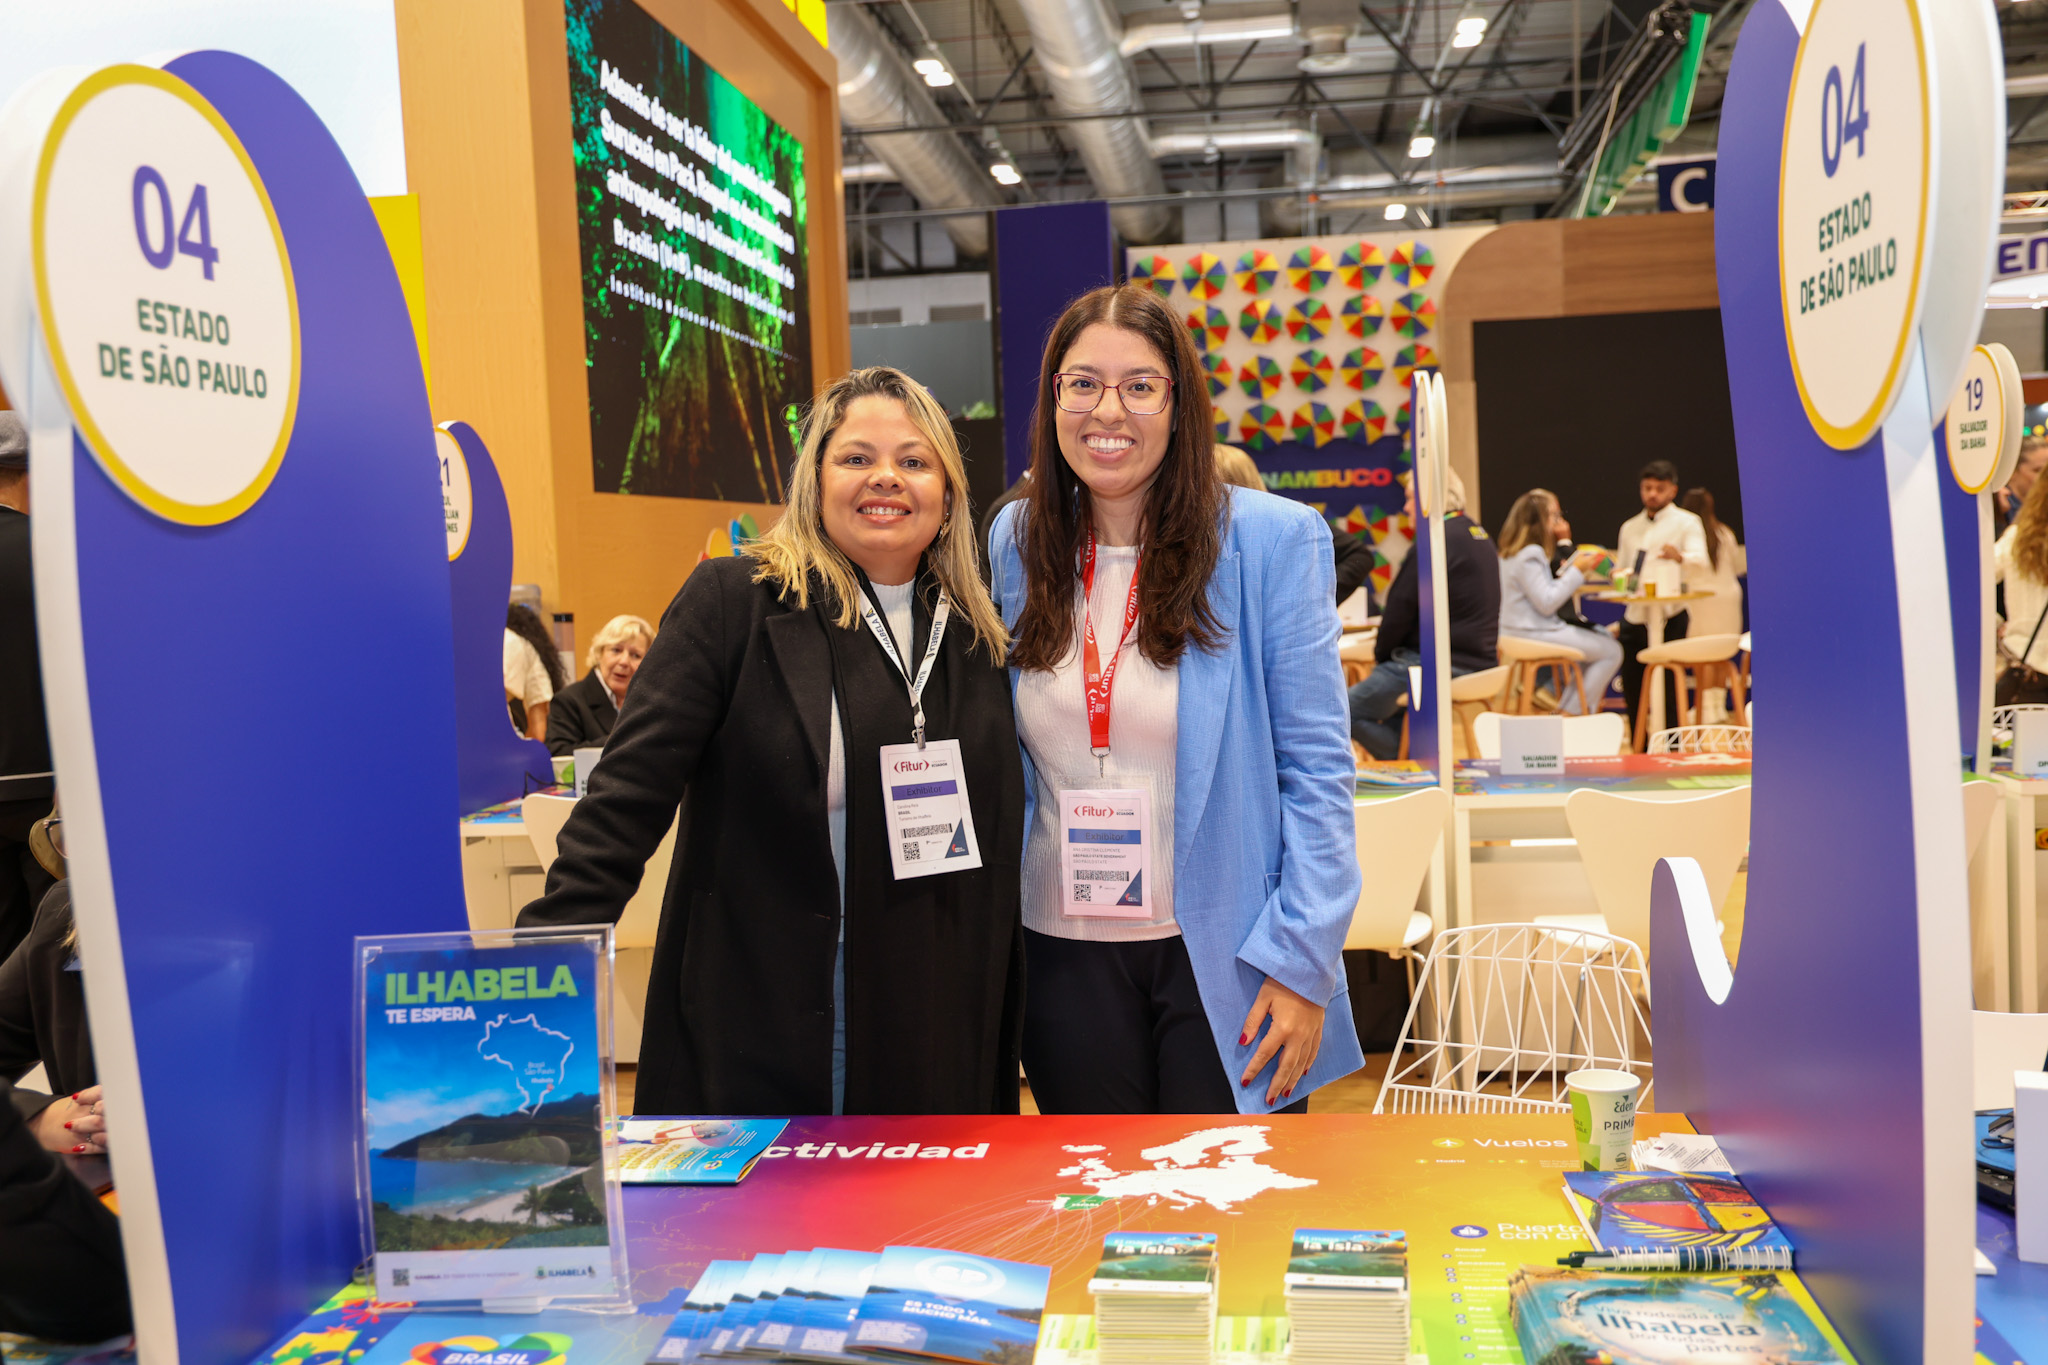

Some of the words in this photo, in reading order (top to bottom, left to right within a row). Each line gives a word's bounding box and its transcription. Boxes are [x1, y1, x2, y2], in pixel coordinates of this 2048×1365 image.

[600, 60, 651, 120] Además
[651, 97, 666, 130] de
[1822, 41, 1869, 178] 04
[607, 169, 682, 231] antropología
[682, 211, 696, 236] en
[132, 165, 219, 282] 04
[1819, 191, 1872, 252] ESTADO
[1800, 276, 1815, 315] DE
[1819, 258, 1844, 306] SÃO
[1849, 237, 1896, 294] PAULO
[137, 298, 230, 346] ESTADO
[98, 342, 134, 381] DE
[141, 344, 190, 388] SÃO
[197, 358, 267, 399] PAULO
[1965, 378, 1983, 412] 19
[1960, 420, 1988, 434] SALVADOR
[1970, 437, 1986, 449] BAHIA
[439, 457, 450, 487] 1
[1261, 467, 1393, 490] NAMBUCO
[443, 495, 452, 506] UL
[871, 618, 896, 655] ILHABELA
[929, 621, 943, 652] ILHABELA
[906, 786, 942, 797] Exhibitor
[1085, 832, 1124, 841] Exhibitor
[386, 965, 579, 1005] ILHABELA
[386, 1009, 407, 1024] TE
[410, 1006, 476, 1023] ESPERA
[1614, 1101, 1633, 1113] Eden
[1473, 1138, 1568, 1148] Vuelos
[1115, 1243, 1135, 1254] la
[1140, 1244, 1176, 1255] Isla
[1302, 1240, 1323, 1251] la
[1328, 1240, 1365, 1252] Isla
[549, 1268, 587, 1278] ILHABELA
[935, 1265, 988, 1283] SP
[902, 1306, 956, 1319] MUCHO
[905, 1300, 922, 1308] ES
[925, 1302, 966, 1314] TODO
[967, 1309, 978, 1317] Y
[1636, 1309, 1709, 1320] rodeada
[1714, 1312, 1735, 1320] de
[1597, 1313, 1760, 1336] Ilhabela
[1663, 1333, 1716, 1344] todas
[1685, 1344, 1763, 1354] partes
[443, 1353, 530, 1365] BRASIL
